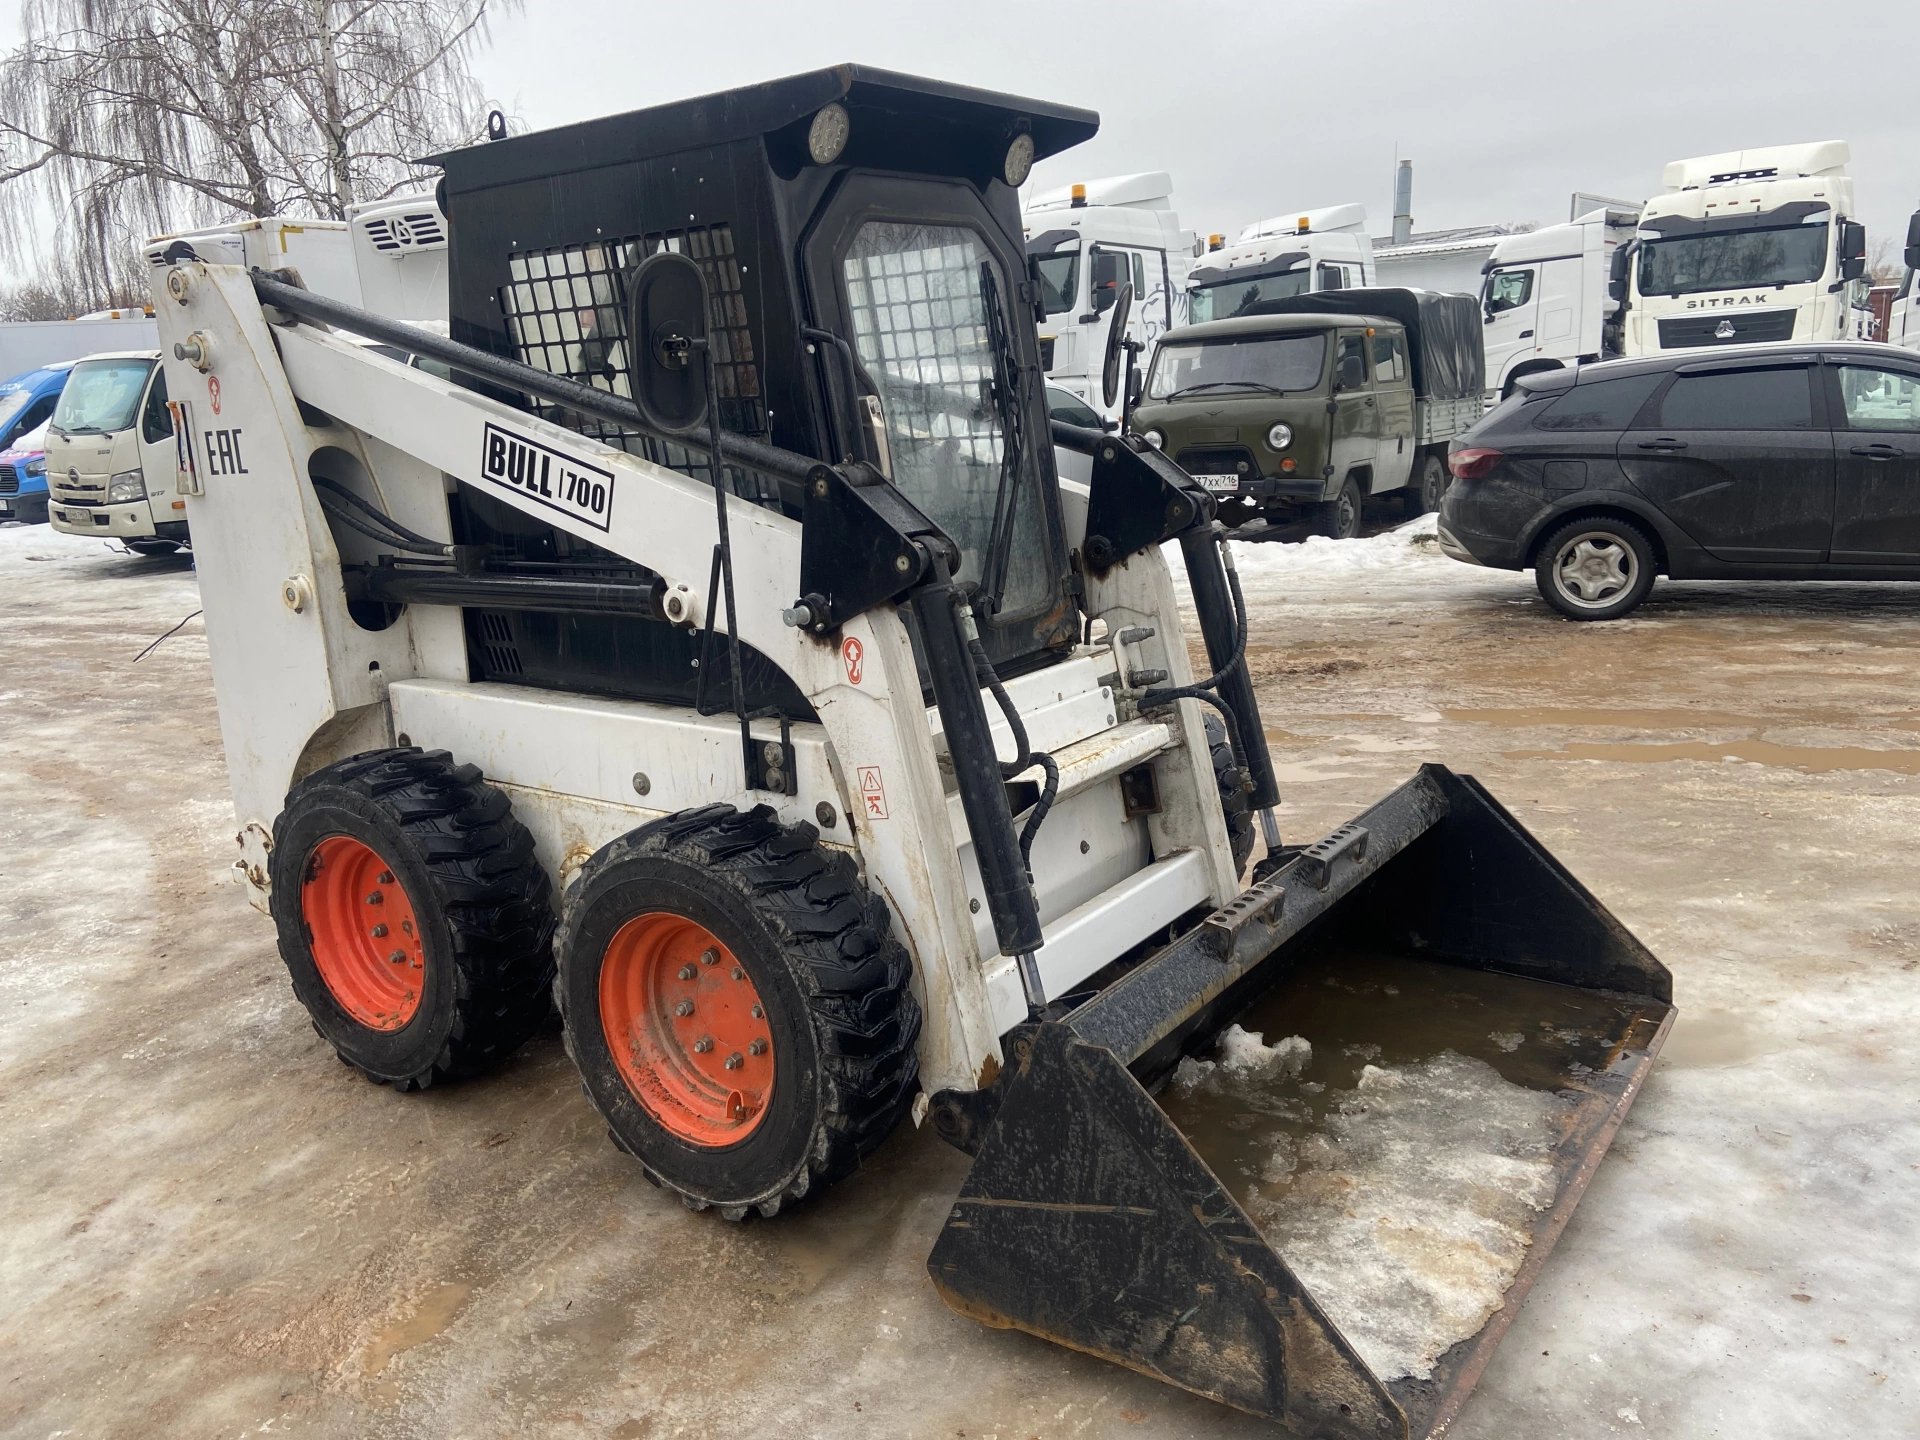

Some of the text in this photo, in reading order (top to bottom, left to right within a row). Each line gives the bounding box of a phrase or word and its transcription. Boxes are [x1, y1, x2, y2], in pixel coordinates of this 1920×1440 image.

[1686, 294, 1767, 308] SITRAK
[204, 428, 248, 475] EAC
[488, 432, 606, 514] BULL 700
